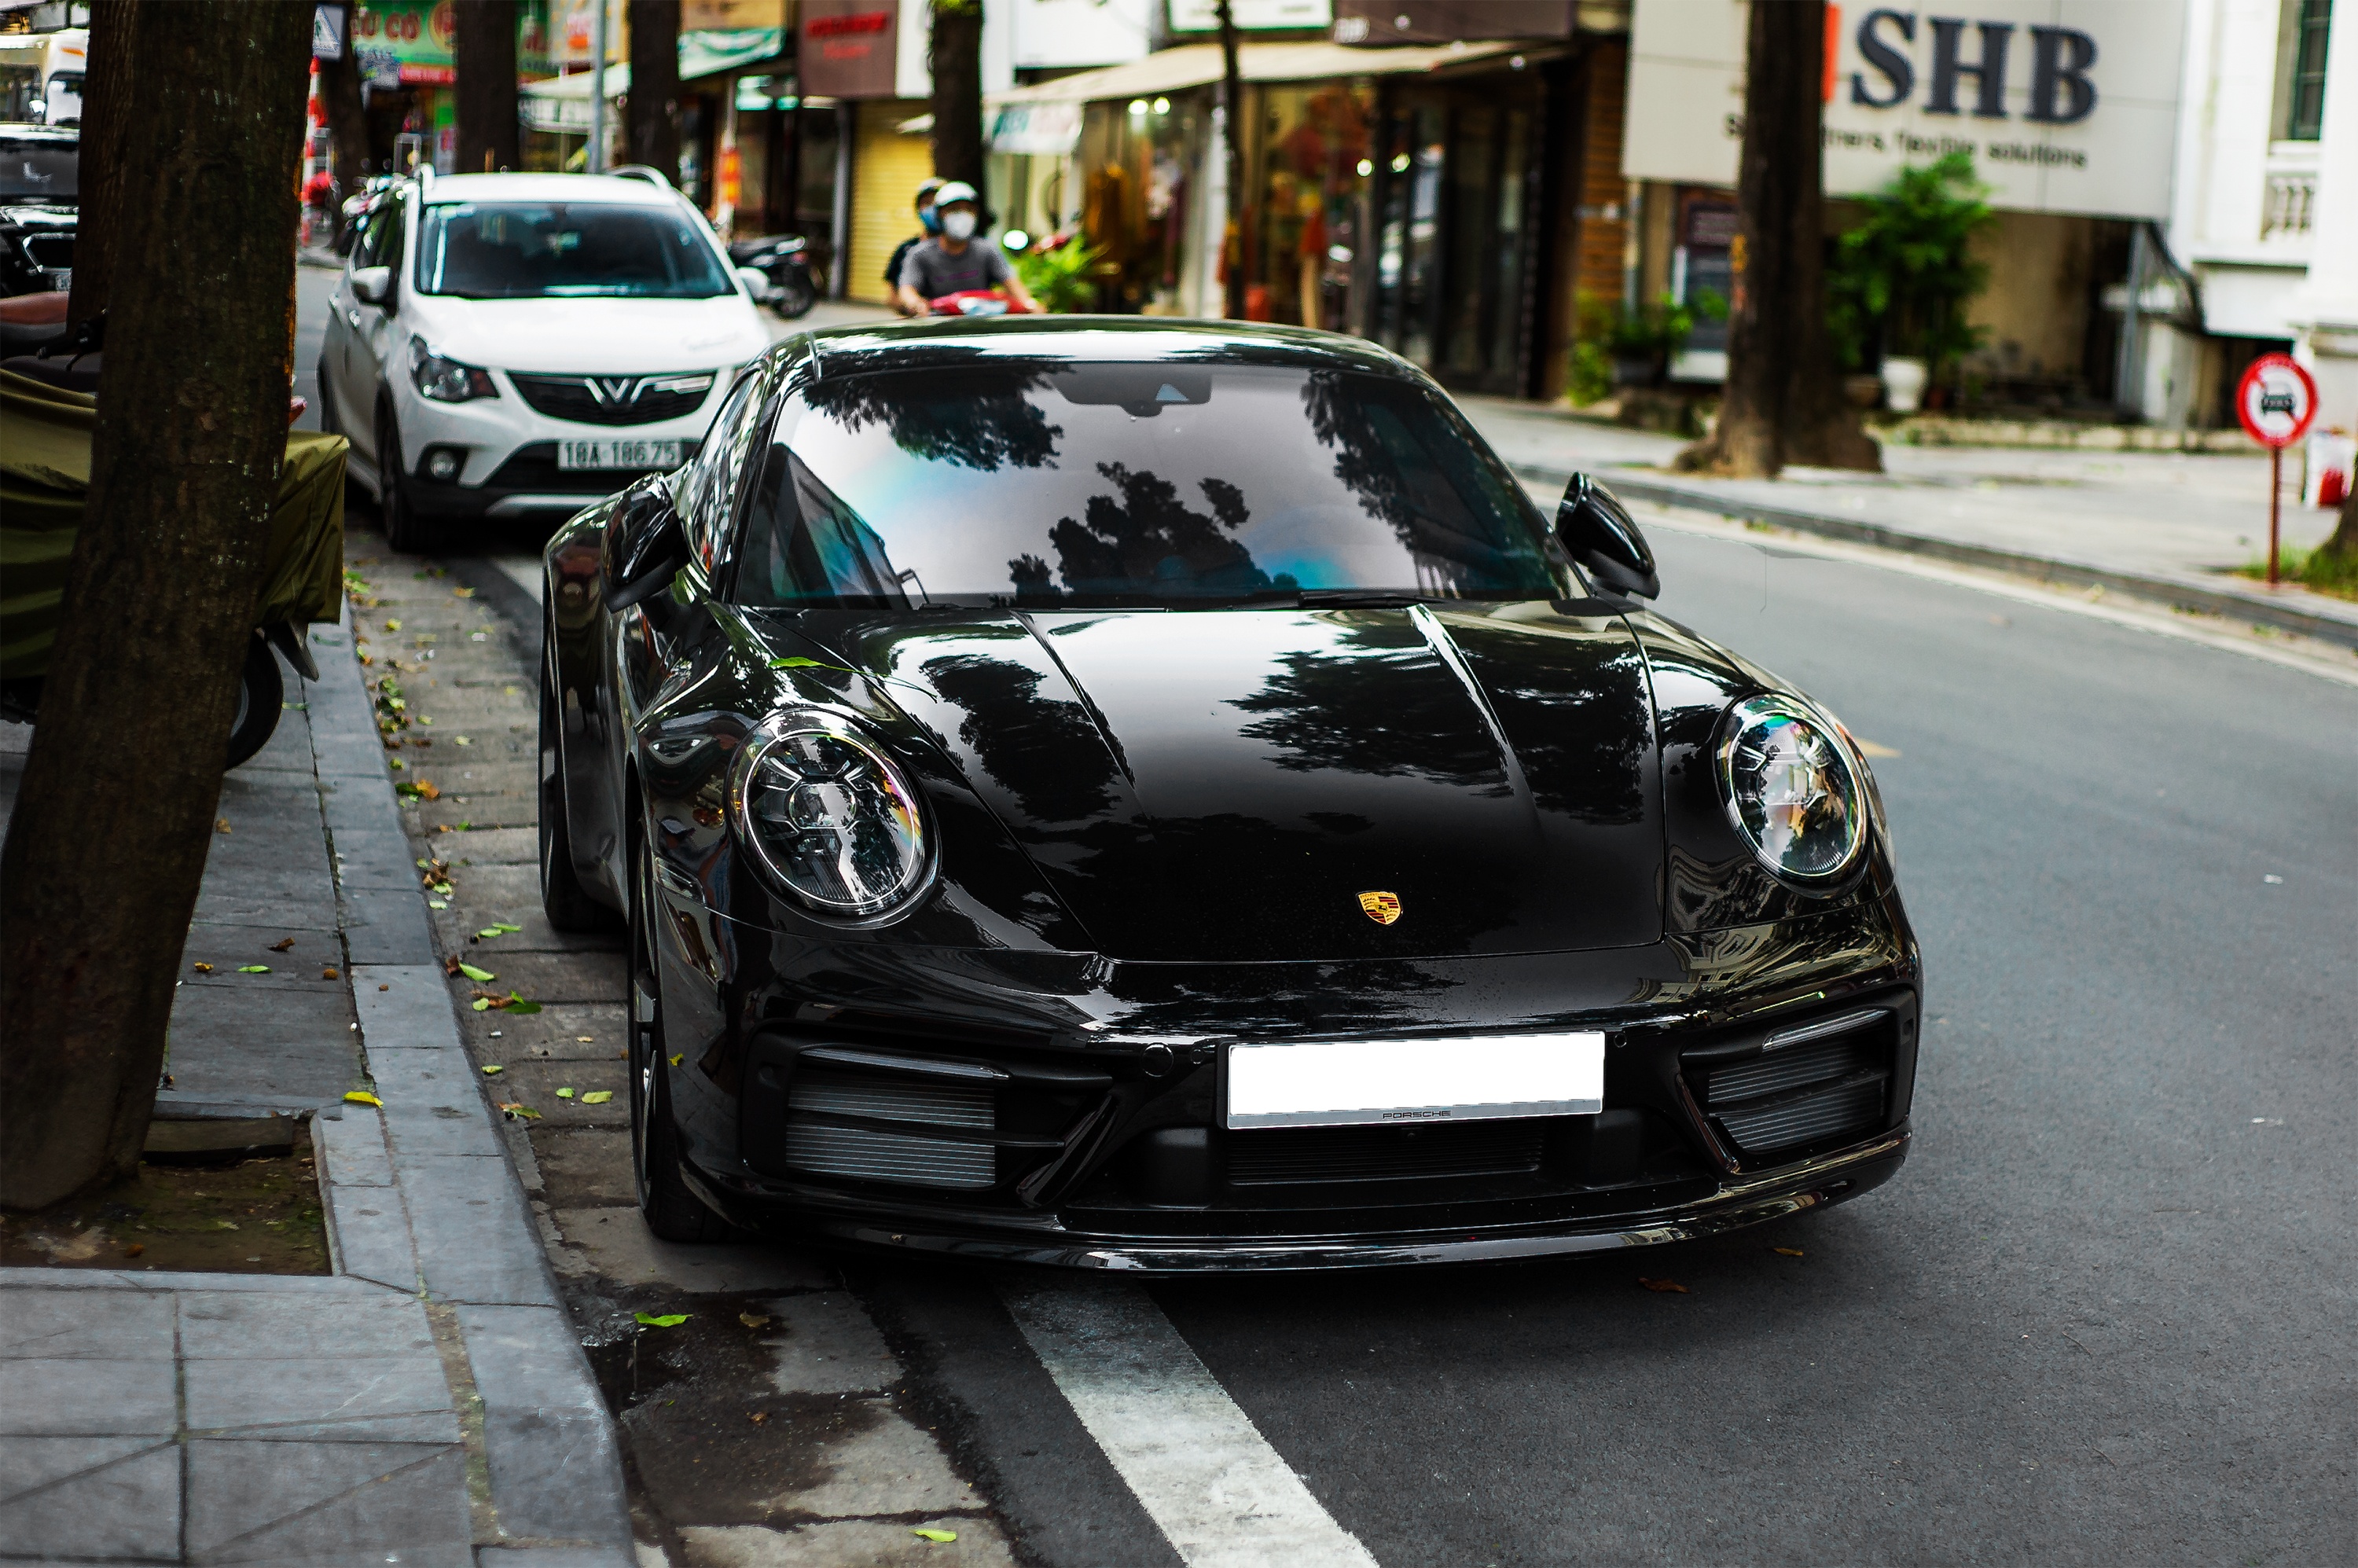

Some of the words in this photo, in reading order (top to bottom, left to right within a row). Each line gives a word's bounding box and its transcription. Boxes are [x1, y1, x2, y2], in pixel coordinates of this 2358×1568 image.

[1851, 8, 2099, 126] SHB
[1988, 141, 2088, 168] solutions
[1383, 1110, 1452, 1119] PORSCHE
